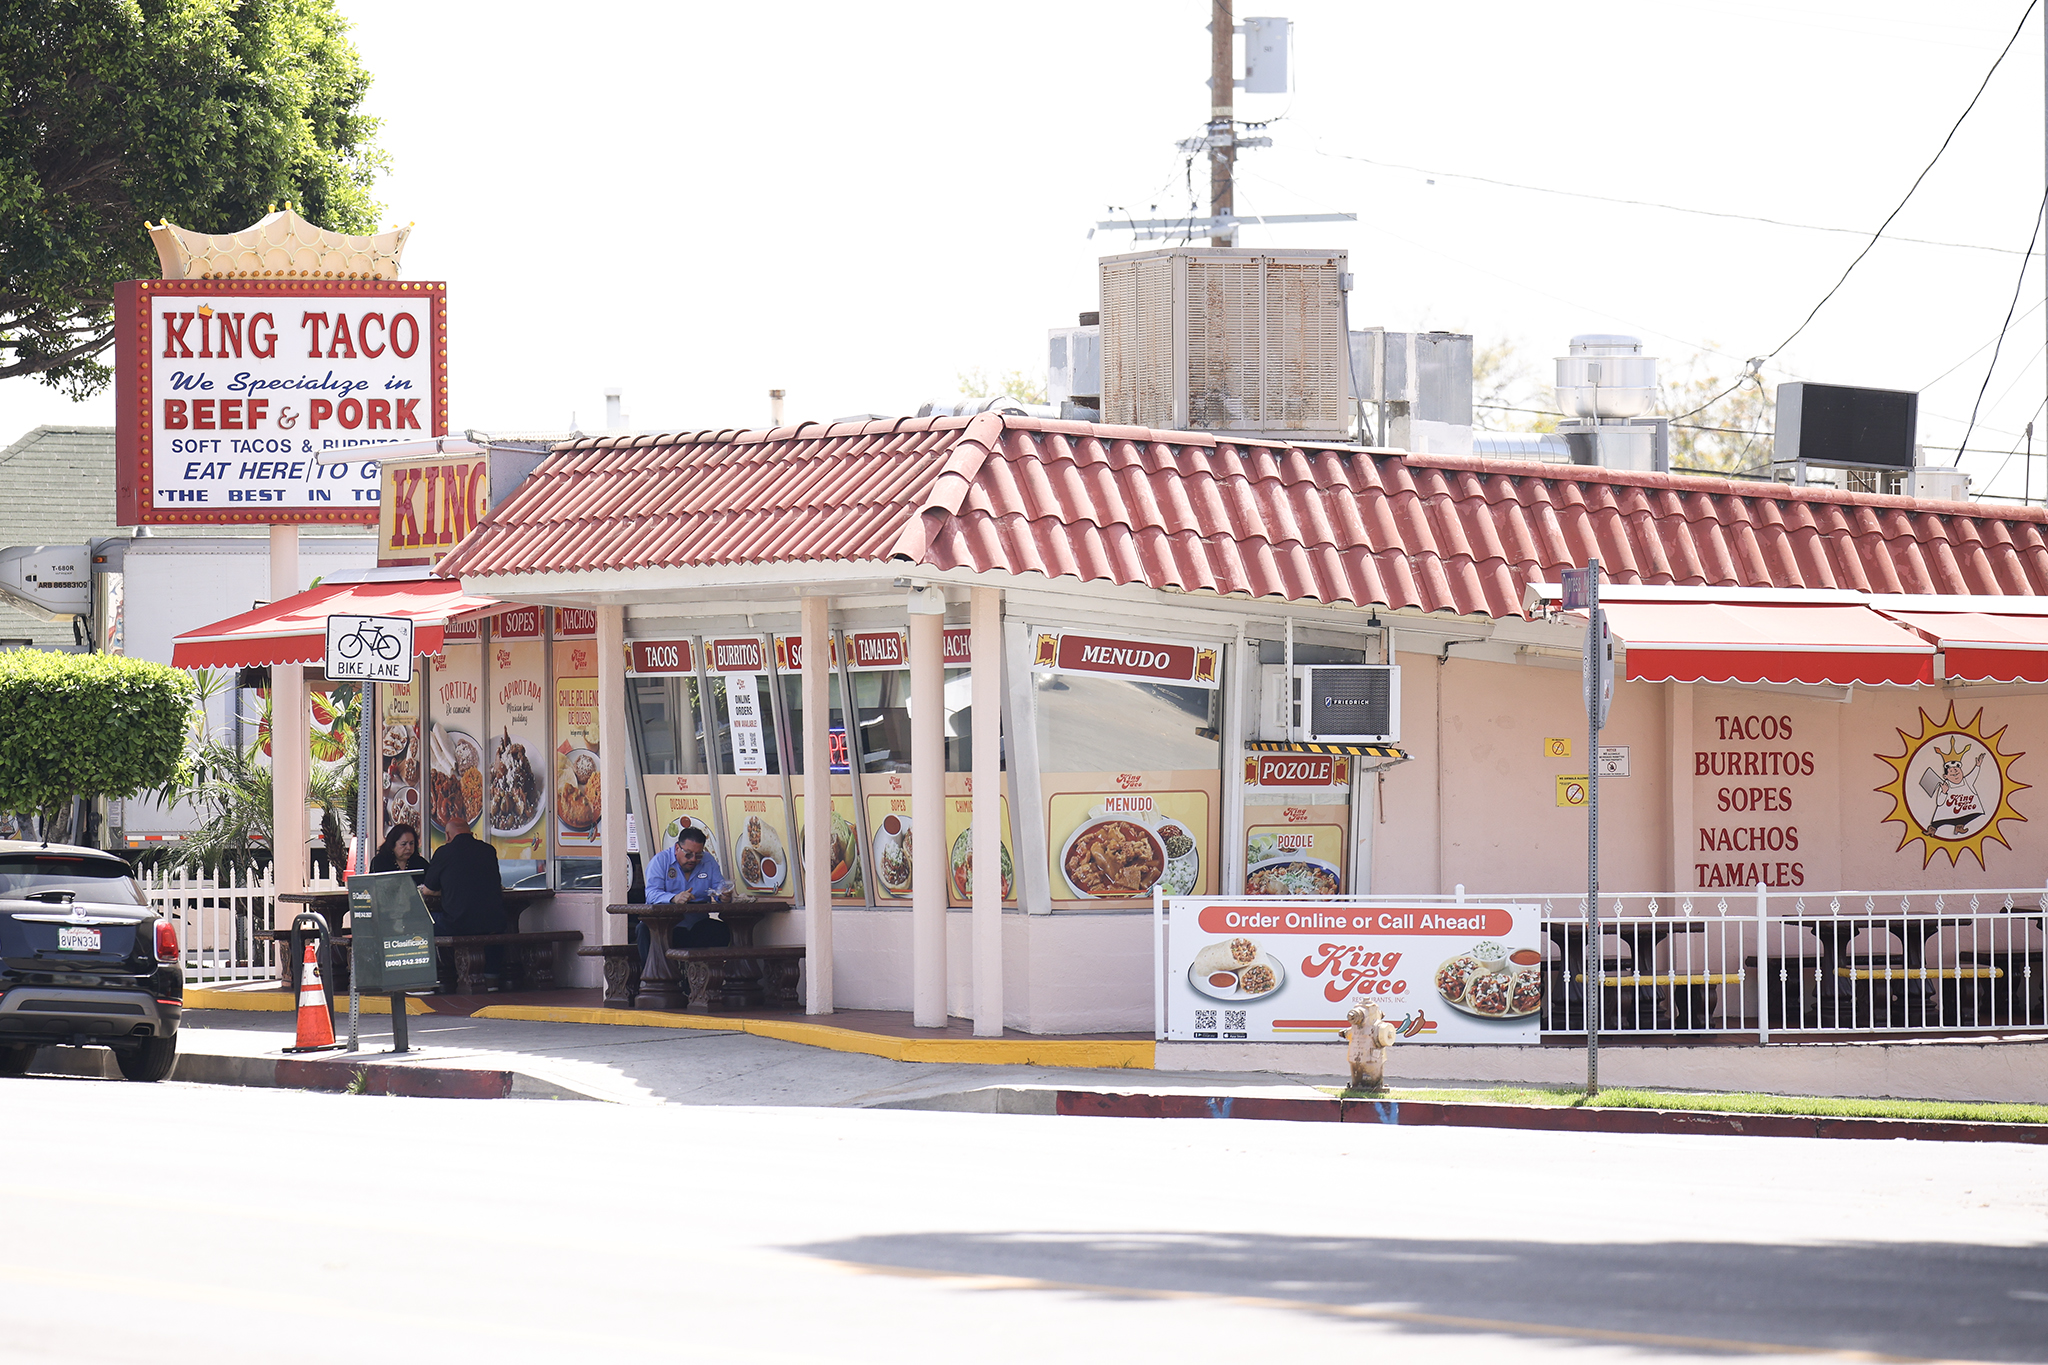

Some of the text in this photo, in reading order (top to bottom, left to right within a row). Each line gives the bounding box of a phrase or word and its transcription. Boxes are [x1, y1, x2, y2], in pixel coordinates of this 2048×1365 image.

[162, 311, 421, 359] KING TACO
[170, 370, 413, 398] We Specialize in
[163, 398, 422, 431] BEEF & PORK
[171, 439, 221, 454] SOFT
[230, 438, 292, 454] TACOS
[301, 438, 313, 454] &
[183, 461, 231, 480] EAT
[360, 461, 382, 480] G
[228, 489, 286, 502] BEST
[308, 489, 331, 502] IN
[352, 489, 381, 502] TO
[389, 460, 487, 550] KING
[38, 581, 53, 589] ARB
[505, 610, 535, 633] SOPES
[563, 609, 595, 631] NACHOS
[717, 643, 759, 666] BURRITOS
[858, 638, 899, 661] TAMALES
[943, 635, 972, 657] ACH
[645, 645, 679, 668] TACOS
[1081, 644, 1171, 671] MENUDO
[339, 661, 399, 677] BIKE LANE
[438, 680, 477, 705] TORTITAS
[499, 679, 542, 705] CAPIROTADA
[558, 689, 575, 707] CHILE
[734, 694, 751, 704] ONLINE
[393, 697, 410, 714] POLLO
[735, 706, 753, 716] ORDERS
[567, 711, 592, 726] DE QUESO
[1715, 715, 1793, 740] TACOS
[829, 733, 850, 765] PE
[1262, 762, 1330, 780] POZOLE
[1694, 751, 1815, 777] BURRITOS
[1116, 773, 1141, 783] King
[1121, 780, 1142, 789] Taco
[669, 798, 699, 812] QUESADILLAS
[743, 800, 767, 812] BURRITOS
[890, 799, 906, 812] SOPES
[1105, 797, 1153, 812] MENUDO
[1716, 787, 1792, 812] SOPES
[1945, 794, 1975, 807] King
[1953, 802, 1977, 814] Taco
[1283, 807, 1307, 816] King
[1288, 814, 1308, 822] Taco
[1277, 835, 1314, 848] POZOLE
[1699, 826, 1799, 853] NACHOS
[1694, 862, 1805, 889] TAMALES
[1225, 912, 1487, 930] Order Online or Call Ahead!
[61, 935, 98, 947] 8VPN334
[383, 940, 391, 949] El
[1301, 942, 1403, 978] King
[1324, 967, 1408, 1003] Taco
